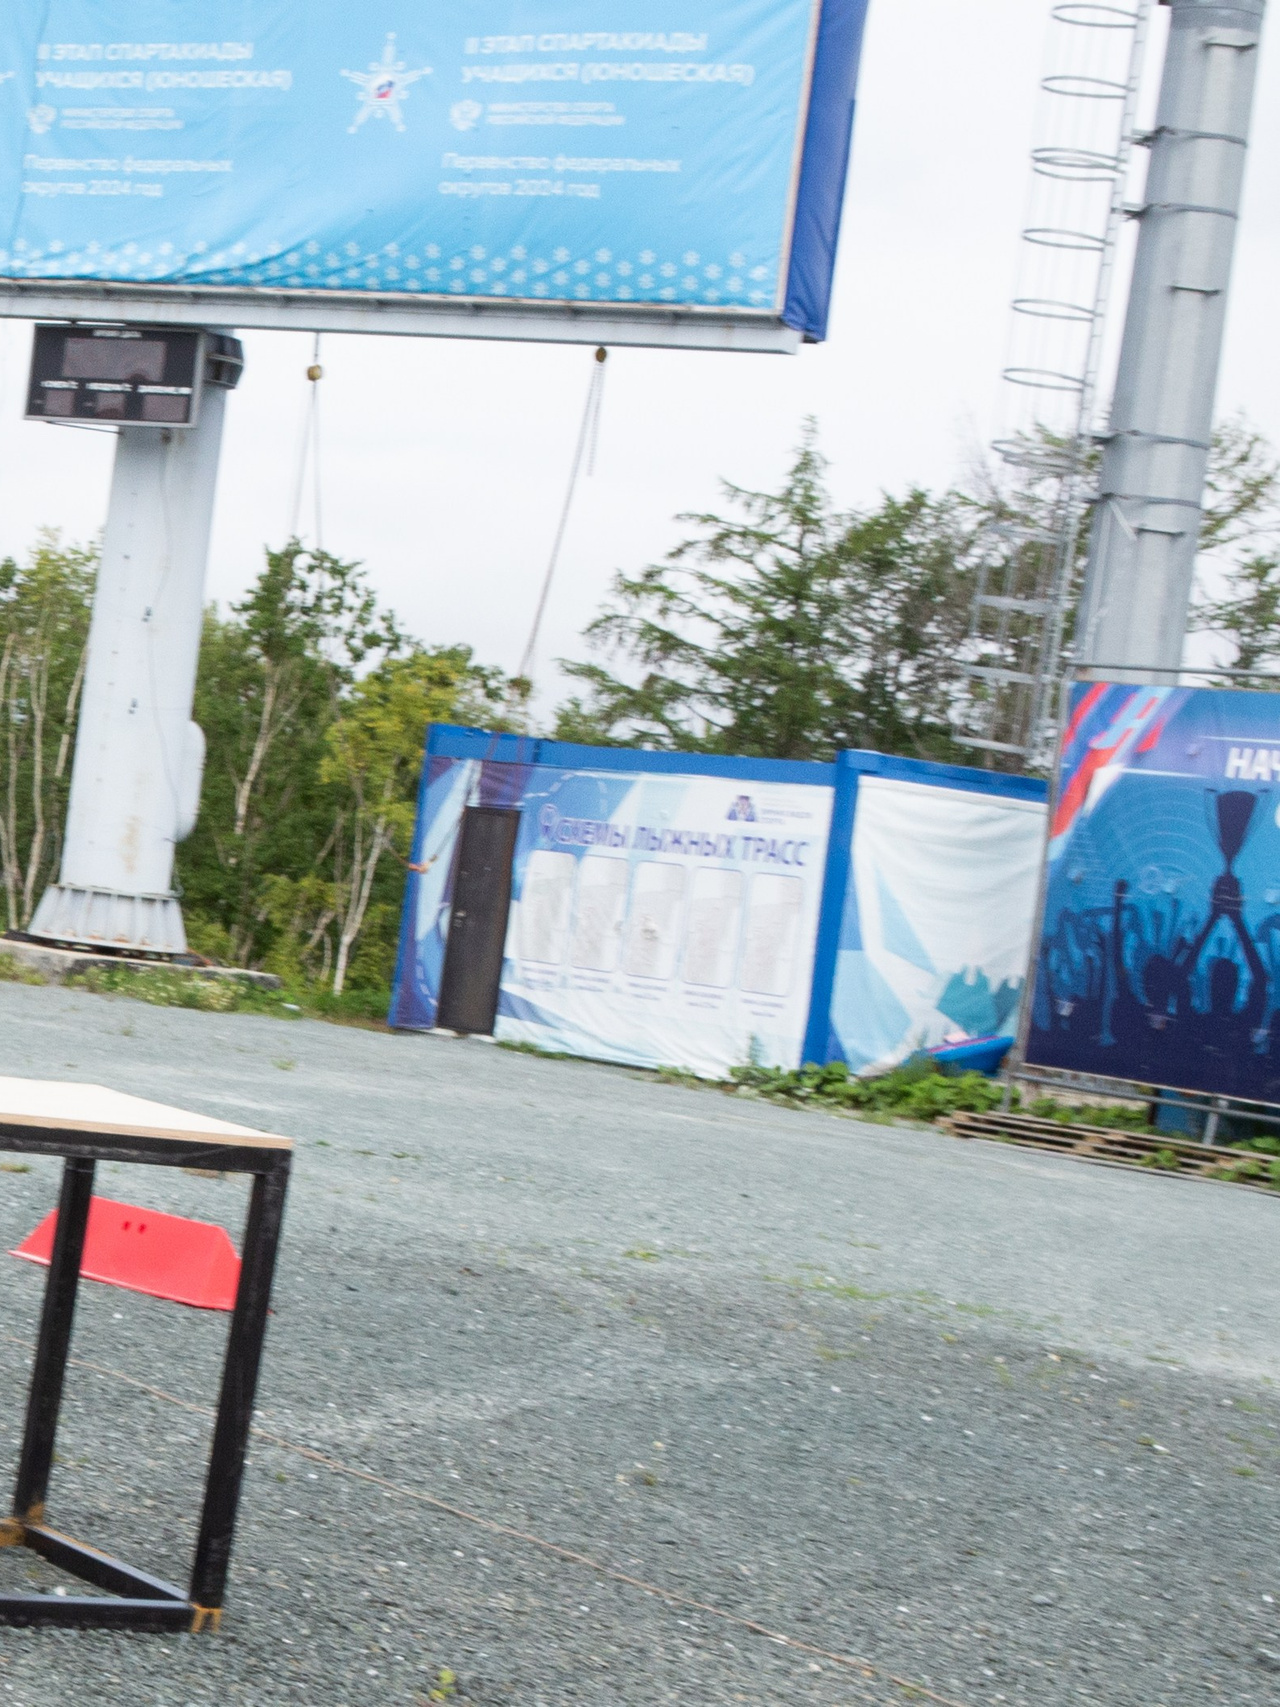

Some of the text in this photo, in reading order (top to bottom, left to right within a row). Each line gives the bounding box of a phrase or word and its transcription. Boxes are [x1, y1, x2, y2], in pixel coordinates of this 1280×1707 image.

[537, 32, 708, 53] СПАРТАКИАДЫ
[633, 827, 736, 858] ЛЫЖНЫХ
[741, 836, 810, 867] ТРАСС
